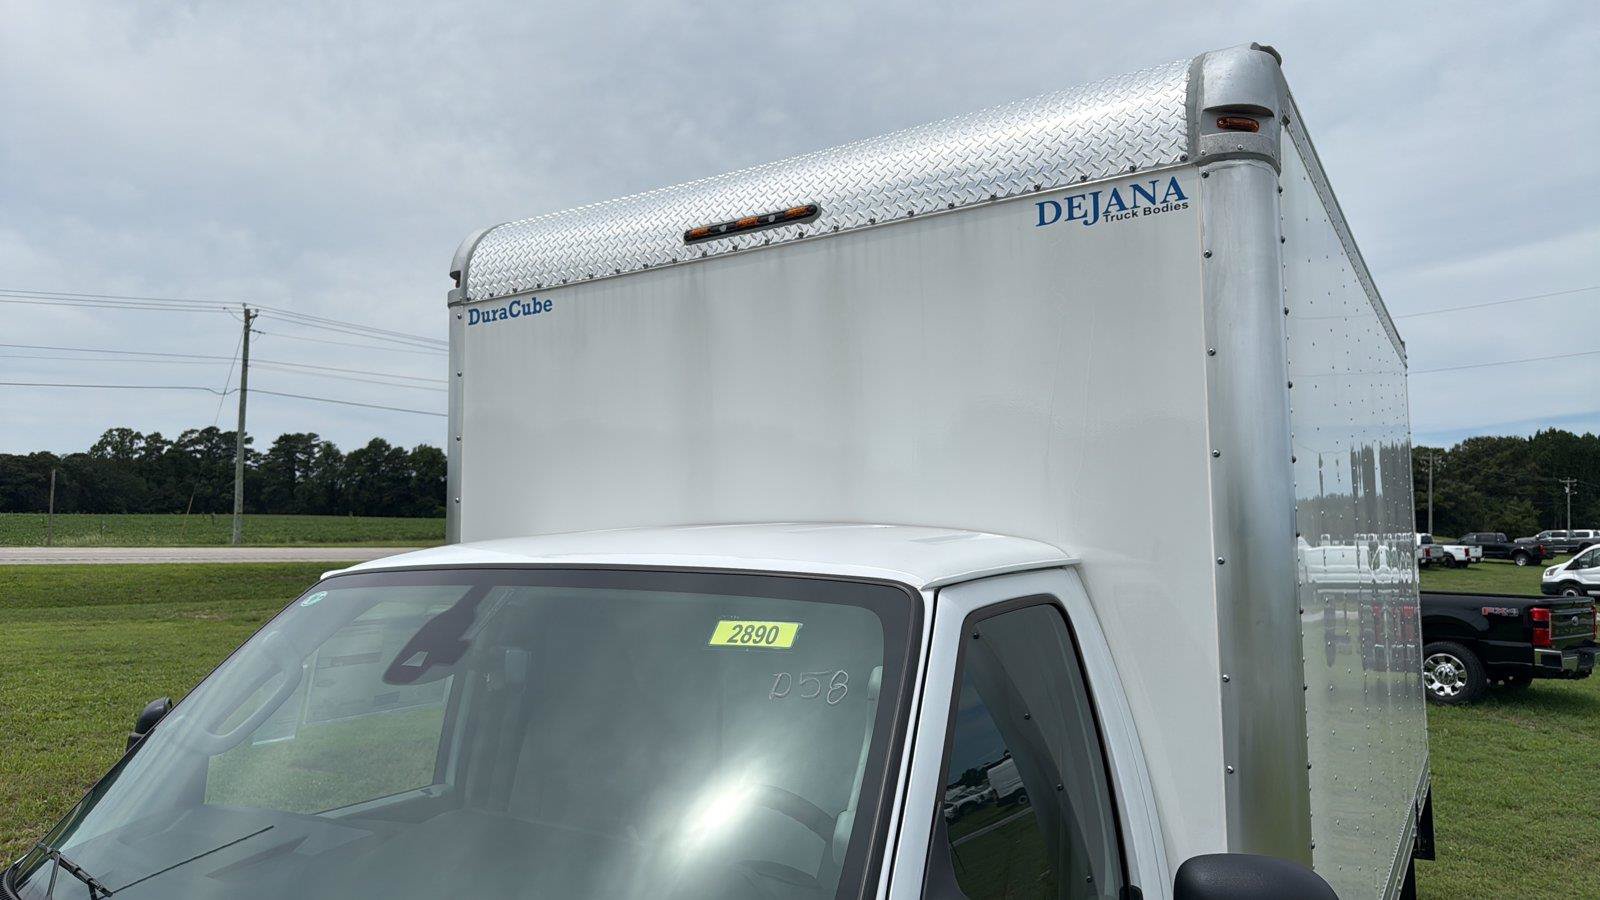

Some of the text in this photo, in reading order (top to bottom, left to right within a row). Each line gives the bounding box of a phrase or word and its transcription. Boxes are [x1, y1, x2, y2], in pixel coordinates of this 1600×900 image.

[1035, 176, 1188, 227] DEJANA
[1103, 201, 1189, 223] Truck Bodies
[468, 297, 553, 325] DuraCube
[727, 624, 780, 645] 2890
